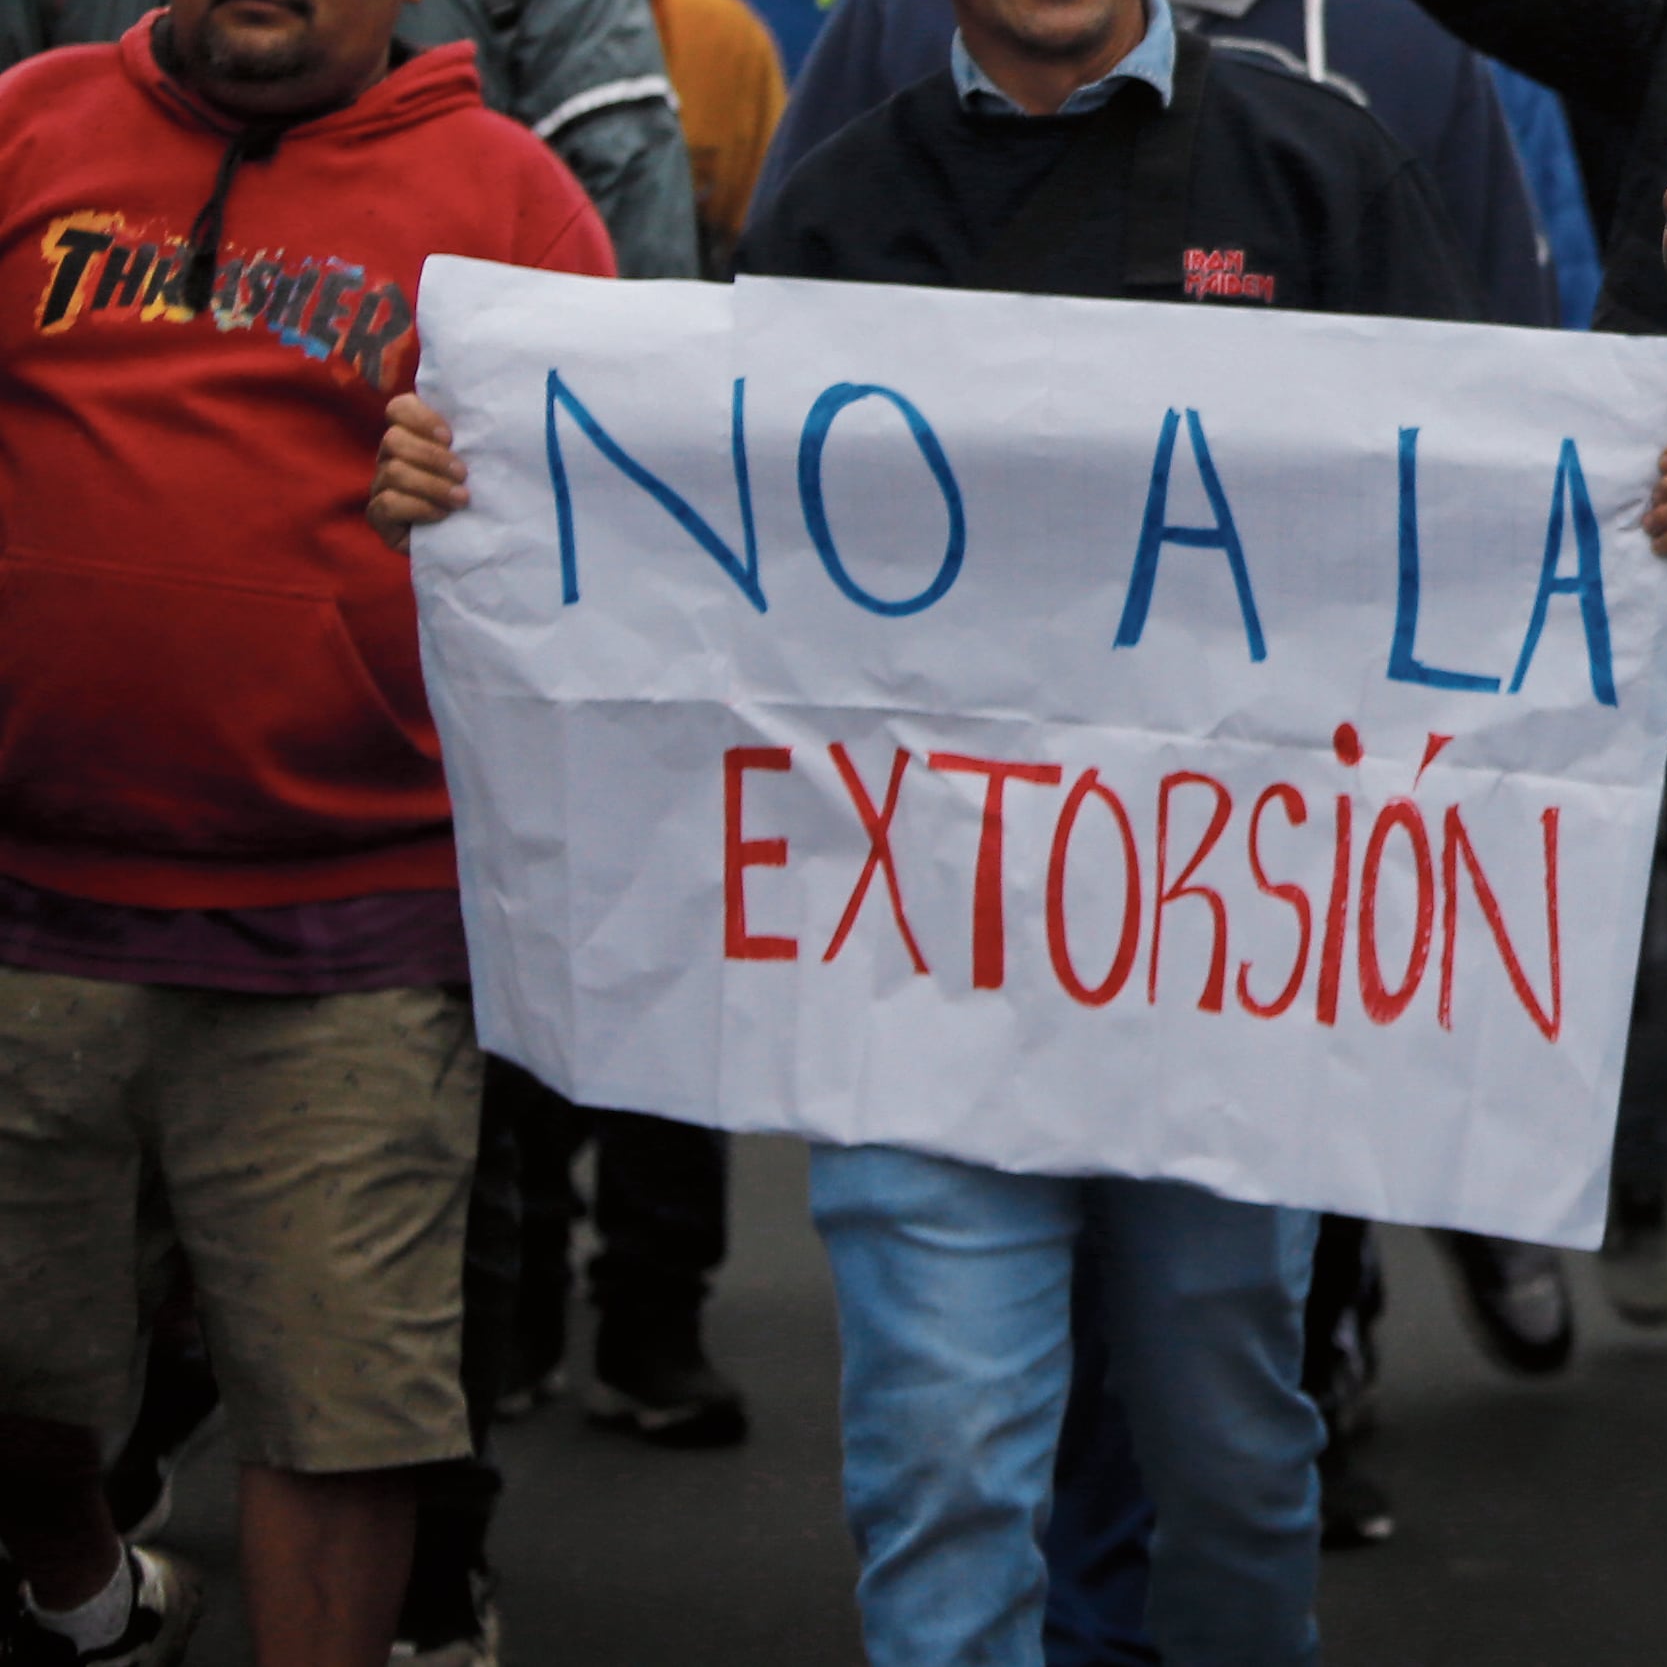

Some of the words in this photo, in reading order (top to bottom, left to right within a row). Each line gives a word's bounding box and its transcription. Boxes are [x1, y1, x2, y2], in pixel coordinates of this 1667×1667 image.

[546, 368, 968, 619] NO
[1112, 407, 1268, 664] A
[1385, 427, 1620, 708] LA
